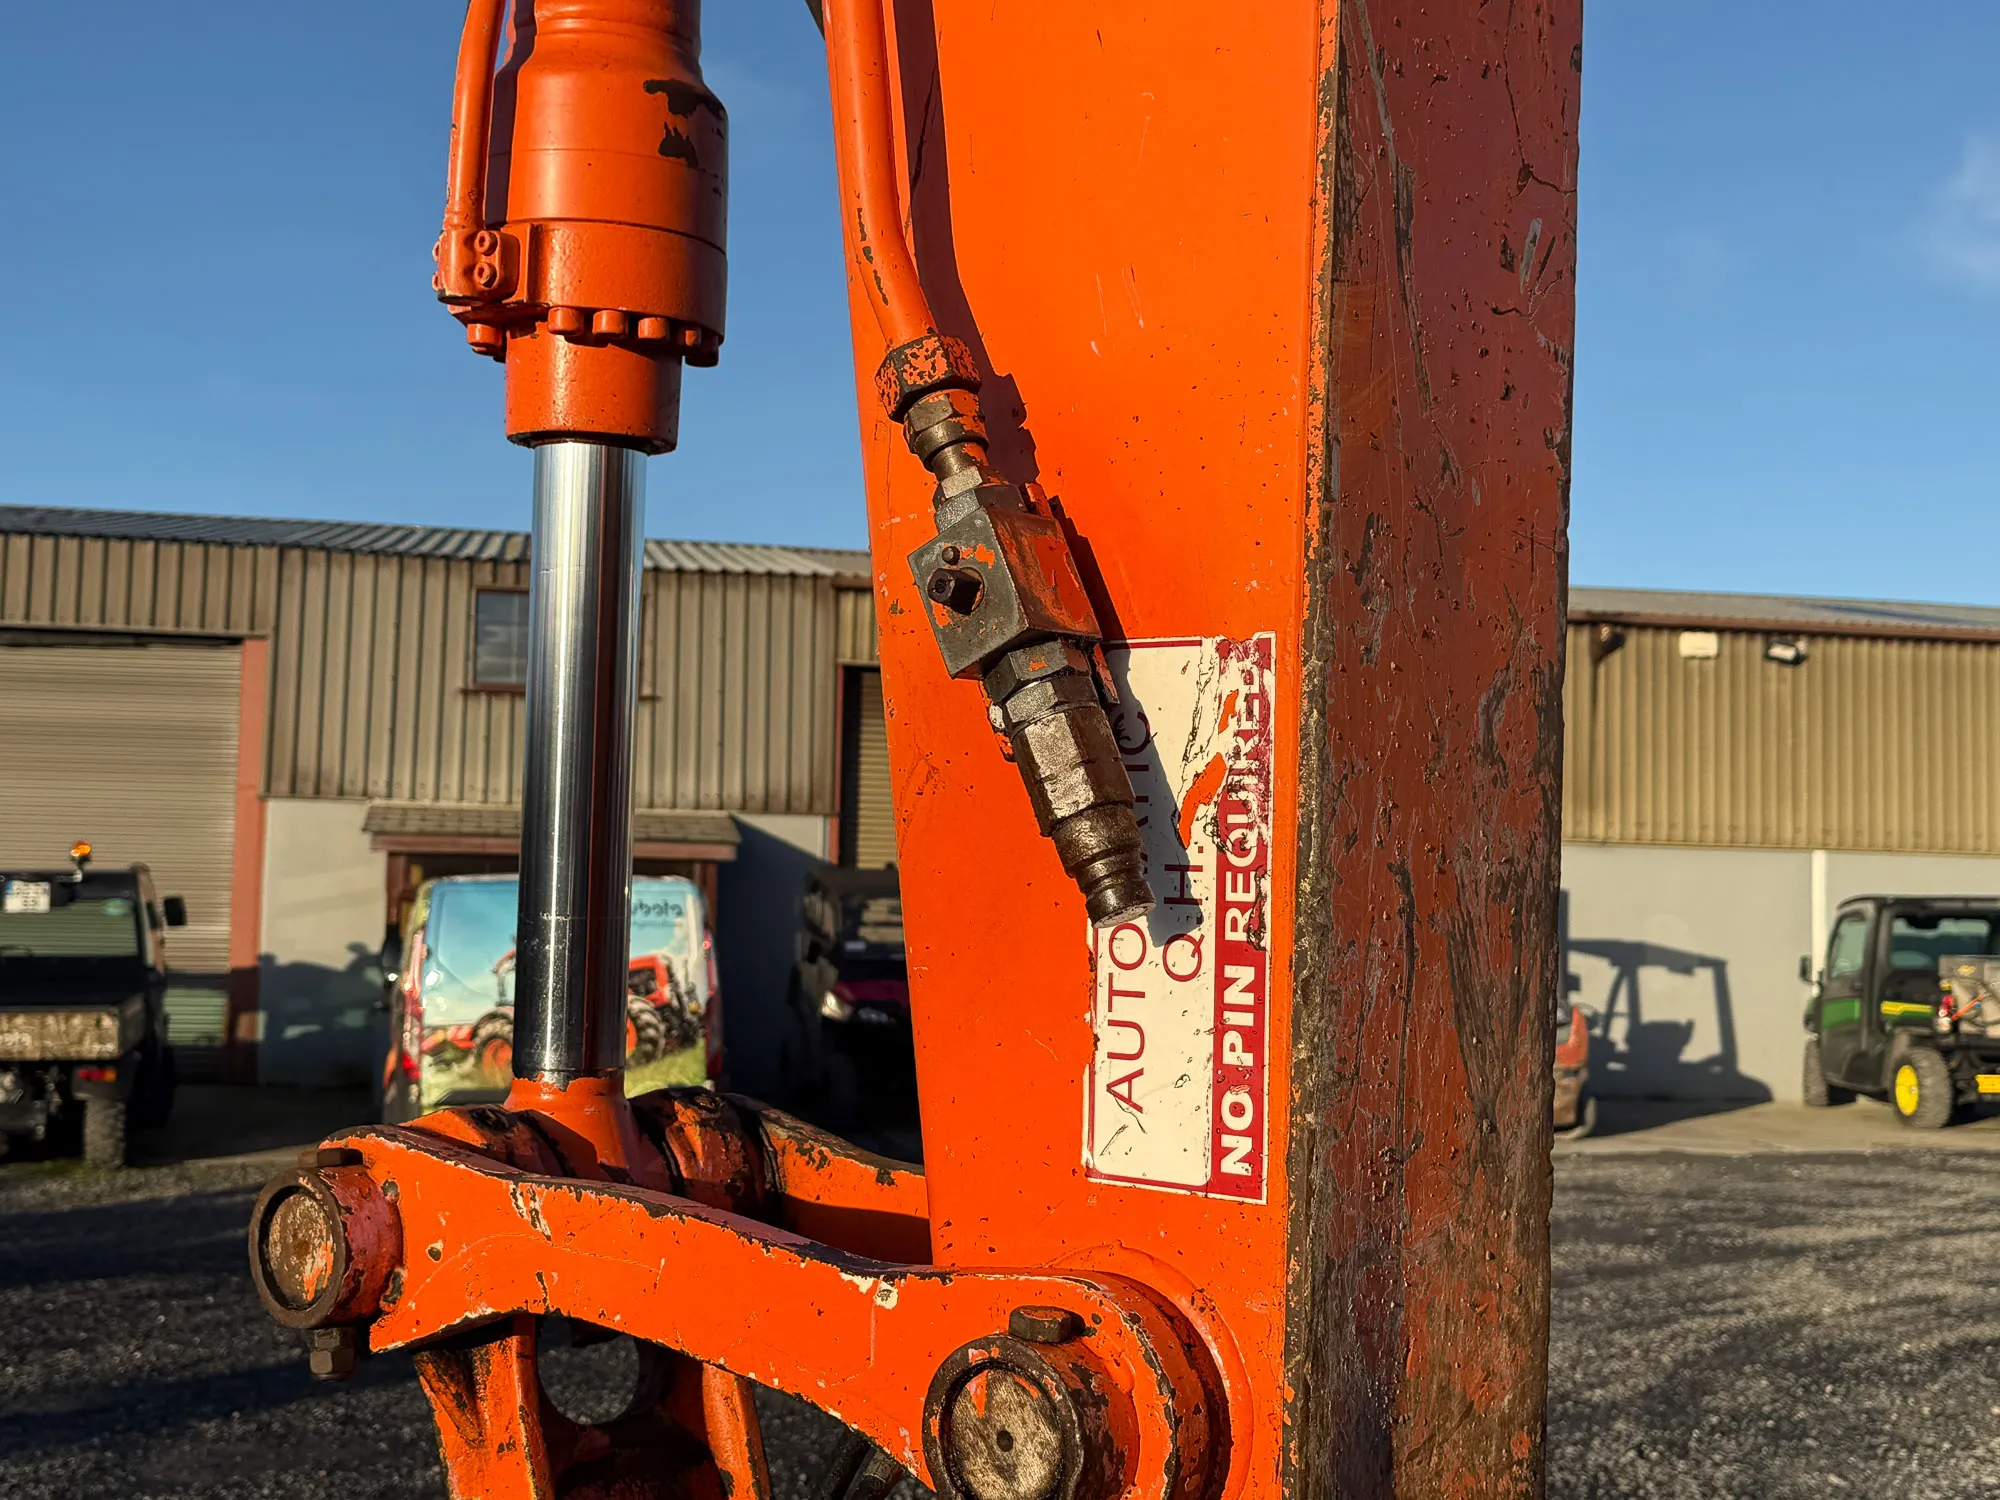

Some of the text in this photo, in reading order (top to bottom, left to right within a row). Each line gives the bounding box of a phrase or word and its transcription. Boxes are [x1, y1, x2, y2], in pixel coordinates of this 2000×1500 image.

[1106, 711, 1150, 1114] AUTOIC
[1220, 661, 1260, 1176] NO PIN REQUIRED
